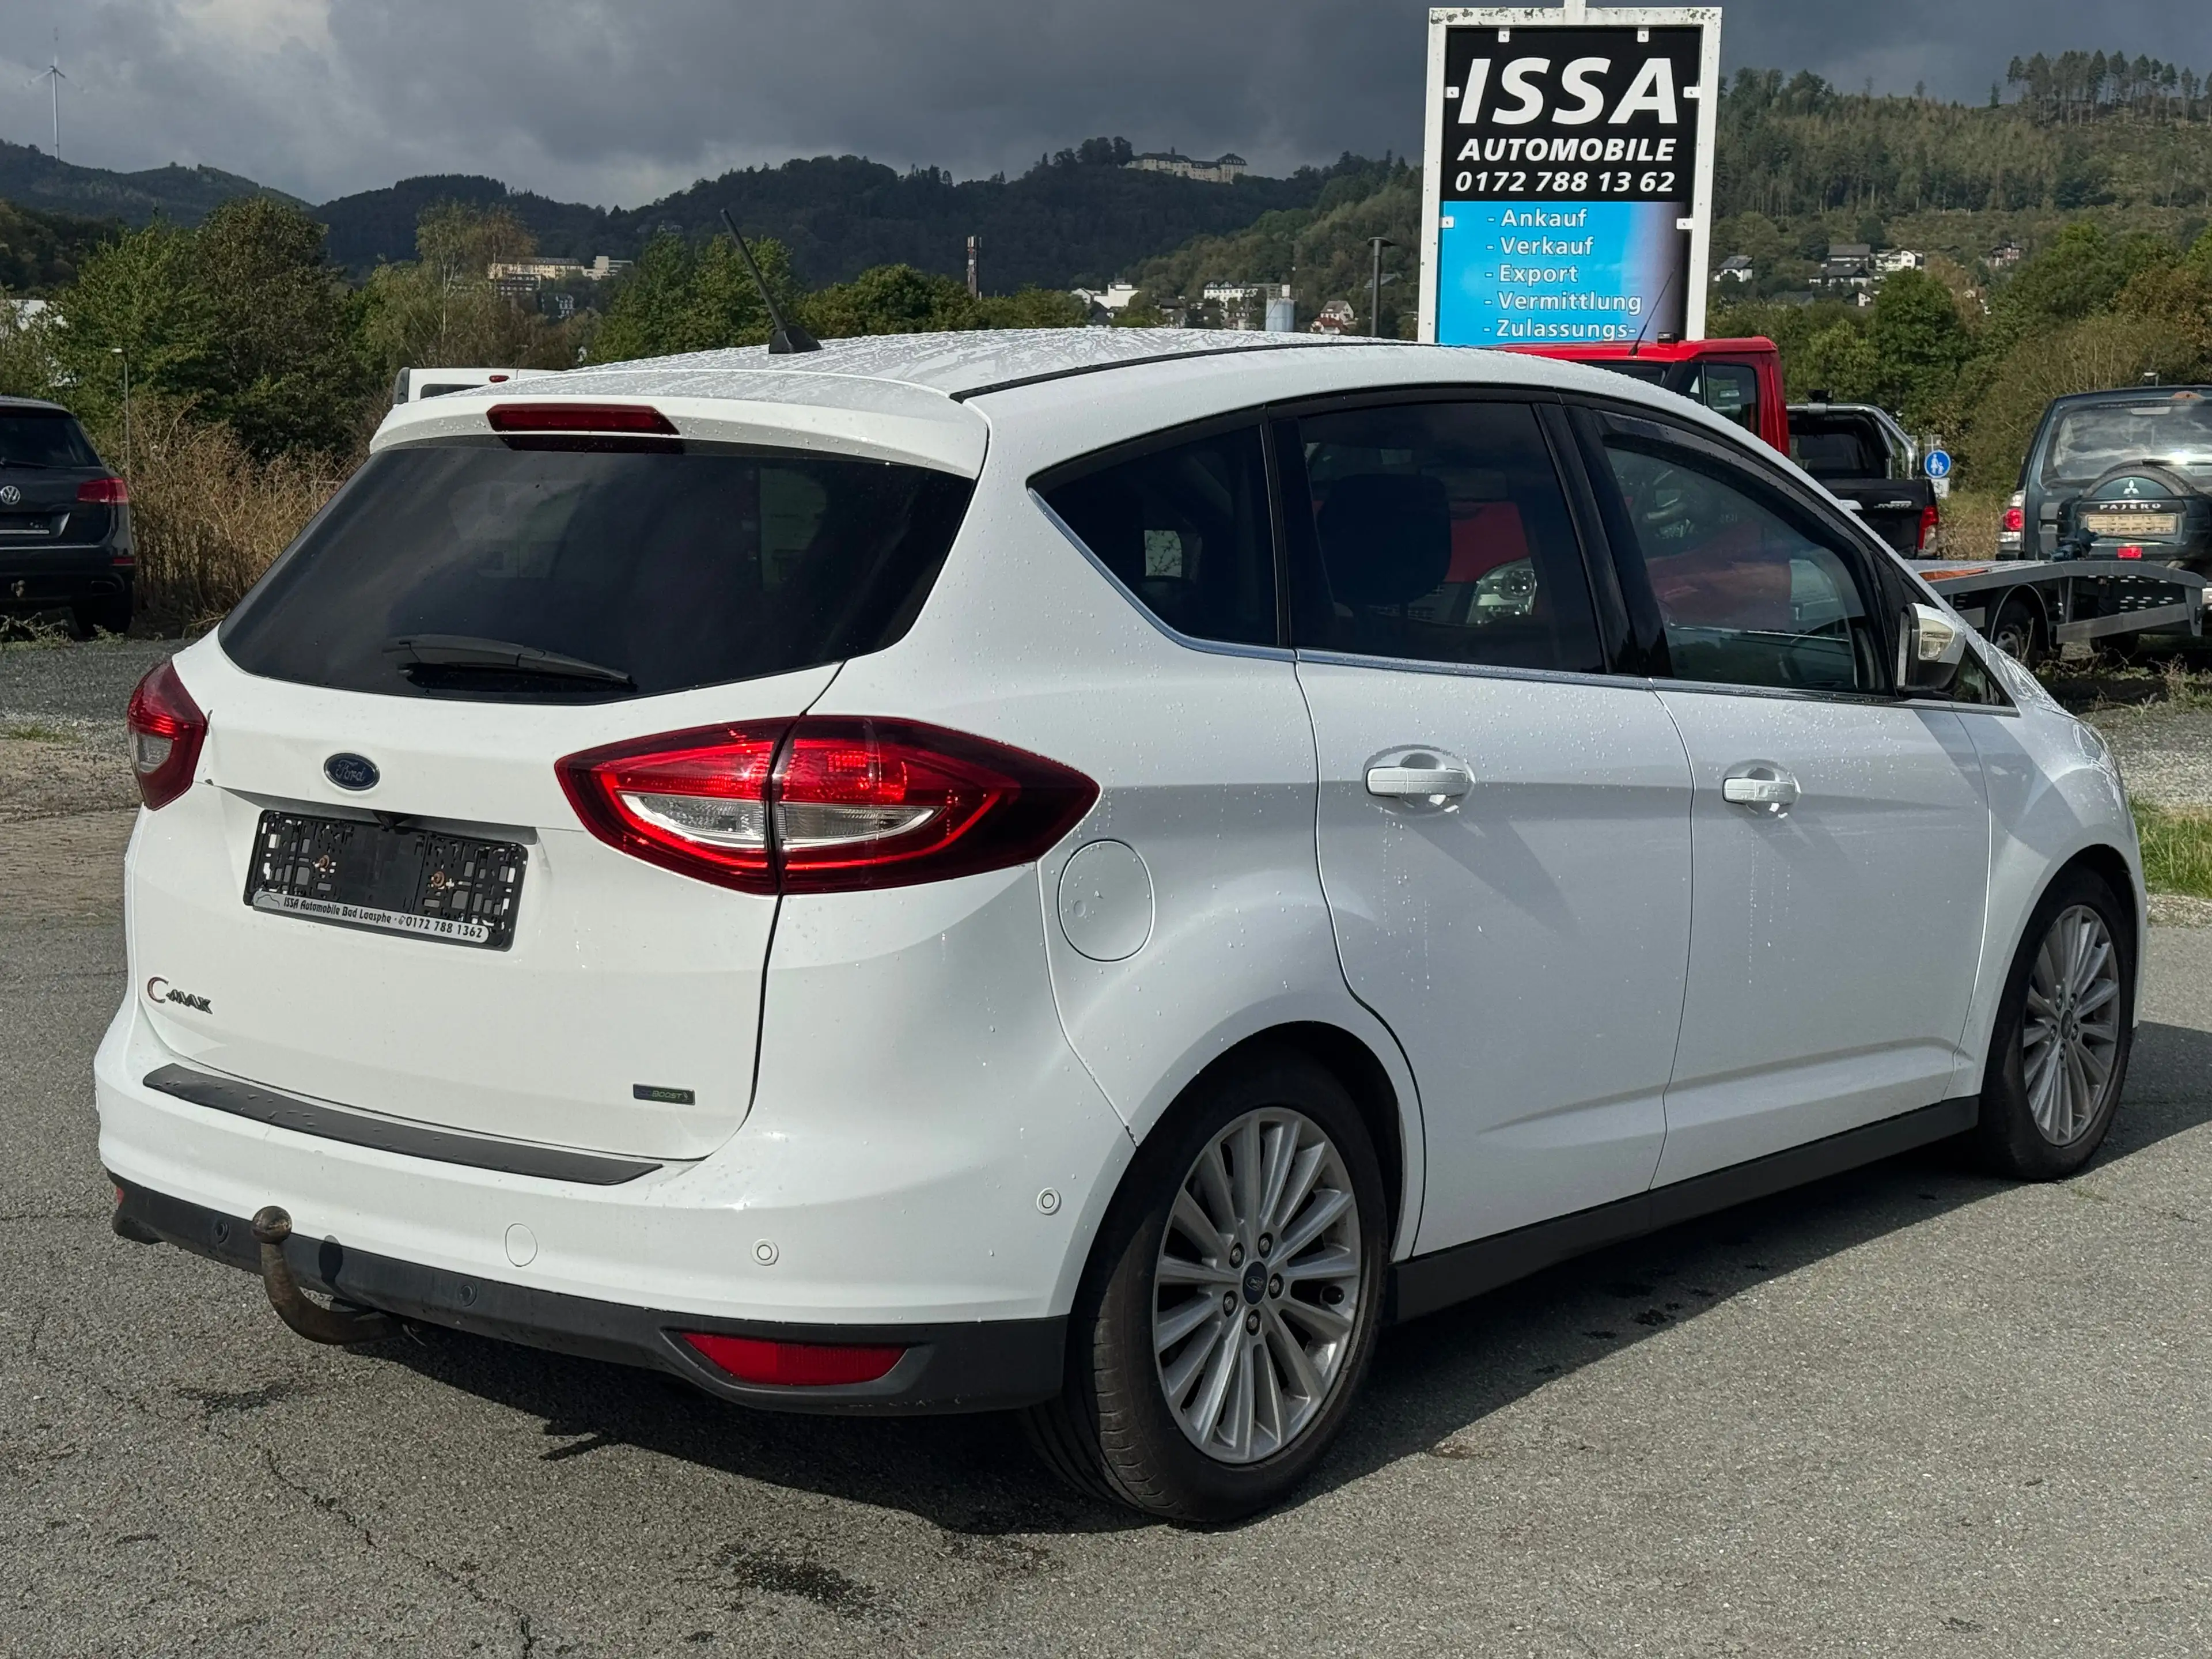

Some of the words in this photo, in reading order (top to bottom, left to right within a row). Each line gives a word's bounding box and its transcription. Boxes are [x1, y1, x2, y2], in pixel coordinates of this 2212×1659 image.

[1458, 58, 1677, 124] ISSA
[1457, 138, 1677, 161] AUTOMOBILE
[1455, 171, 1527, 192] 0172
[1535, 171, 1589, 192] 788
[1501, 208, 1588, 228] Ankauf
[1500, 236, 1594, 255] Verkauf
[1499, 263, 1578, 287] Export
[1498, 291, 1642, 315] Vermittlung
[1496, 318, 1637, 341] Zulassungs-
[335, 759, 367, 782] Ford
[283, 896, 299, 909] ISSA
[300, 899, 340, 915] Automobile
[342, 906, 358, 918] Bad
[359, 910, 392, 924] Laasphe
[406, 918, 430, 929] 0172
[434, 921, 453, 933] 788
[457, 925, 483, 938] 1362
